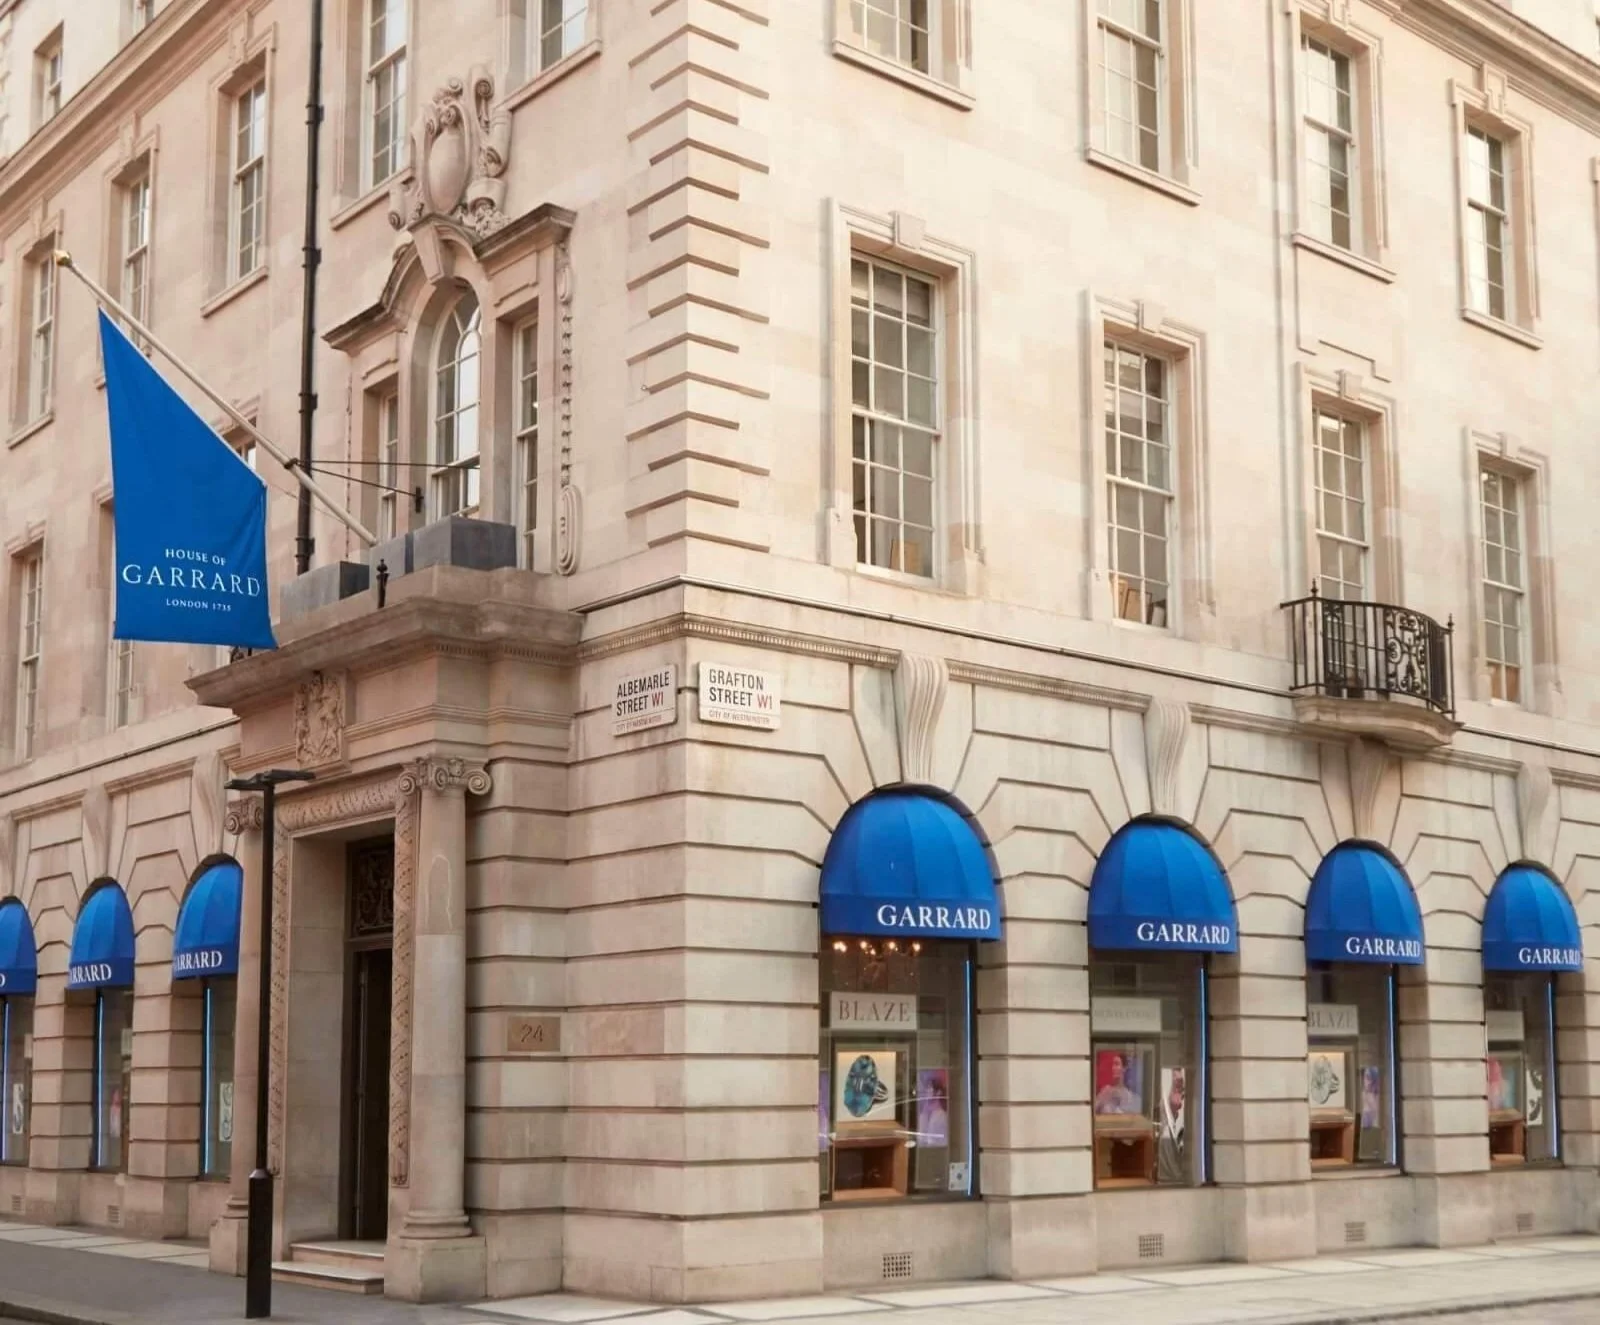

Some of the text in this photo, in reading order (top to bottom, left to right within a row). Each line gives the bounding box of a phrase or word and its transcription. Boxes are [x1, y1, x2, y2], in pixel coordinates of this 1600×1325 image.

[165, 548, 227, 566] HOUSE OF
[122, 563, 261, 597] GARRARD
[166, 598, 209, 609] LONDON
[616, 671, 670, 698] ALBEMARLE
[709, 668, 764, 691] GRAFTON
[616, 691, 664, 717] STREET W1
[709, 686, 773, 710] STREET W1
[877, 904, 991, 930] GARRARD
[1136, 922, 1230, 945] GARRARD
[1345, 936, 1421, 958] GARRARD
[1518, 947, 1581, 966] GARRARD
[839, 1000, 911, 1022] BLAZE
[520, 1023, 544, 1043] 24
